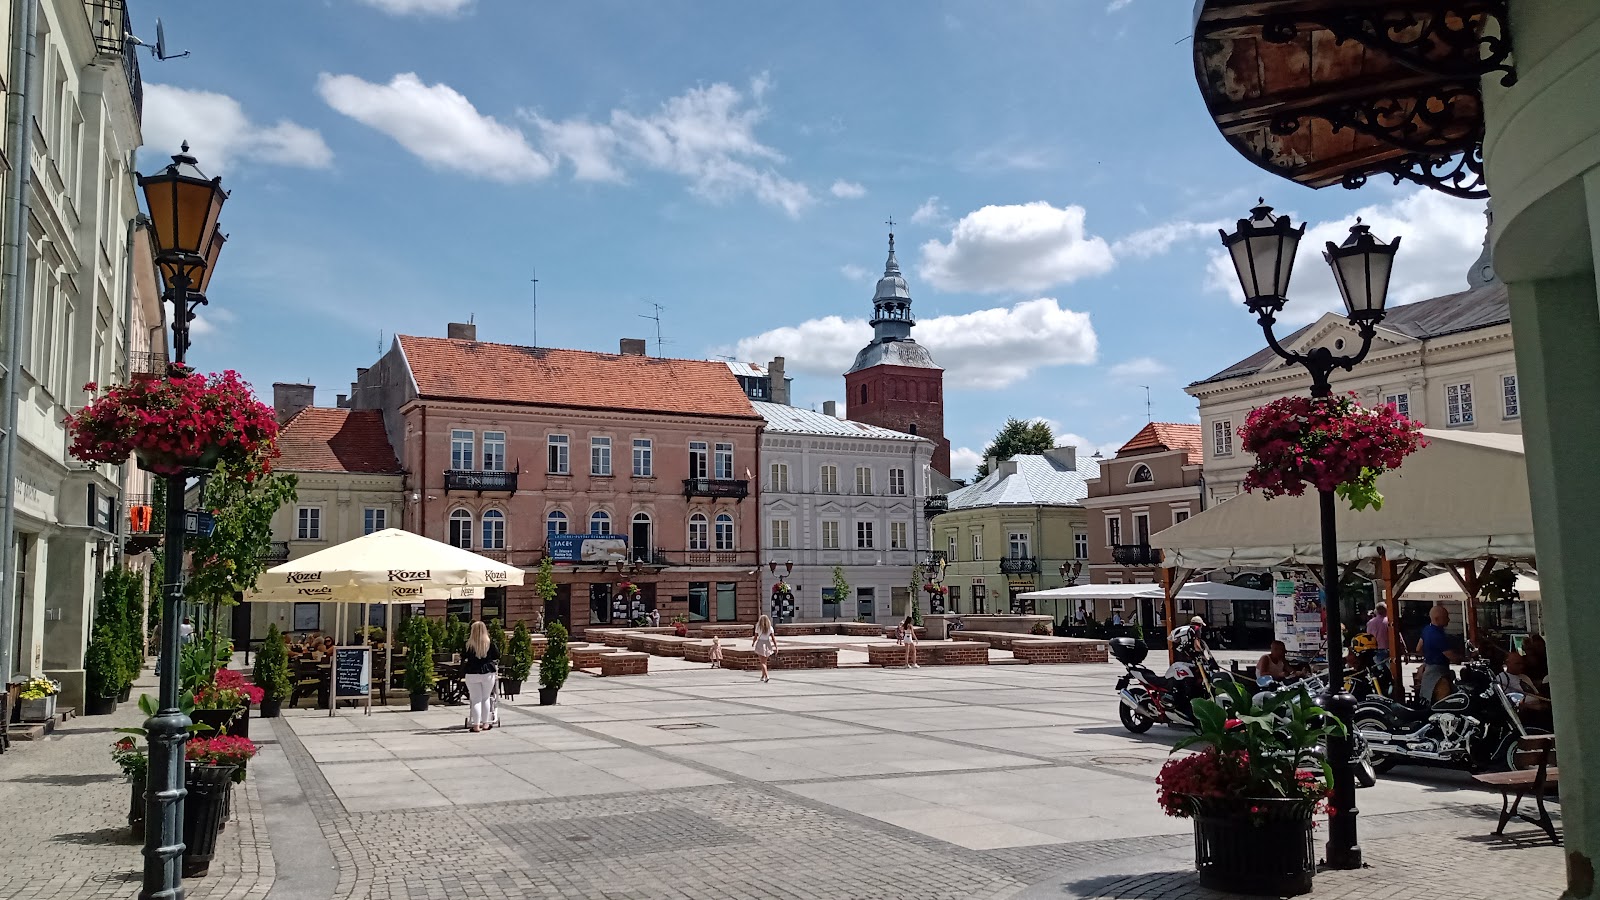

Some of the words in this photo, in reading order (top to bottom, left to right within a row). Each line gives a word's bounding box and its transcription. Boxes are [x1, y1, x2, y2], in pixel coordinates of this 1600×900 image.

[285, 571, 323, 583] Kozel
[387, 569, 432, 582] Kozel
[484, 570, 507, 582] Kozel
